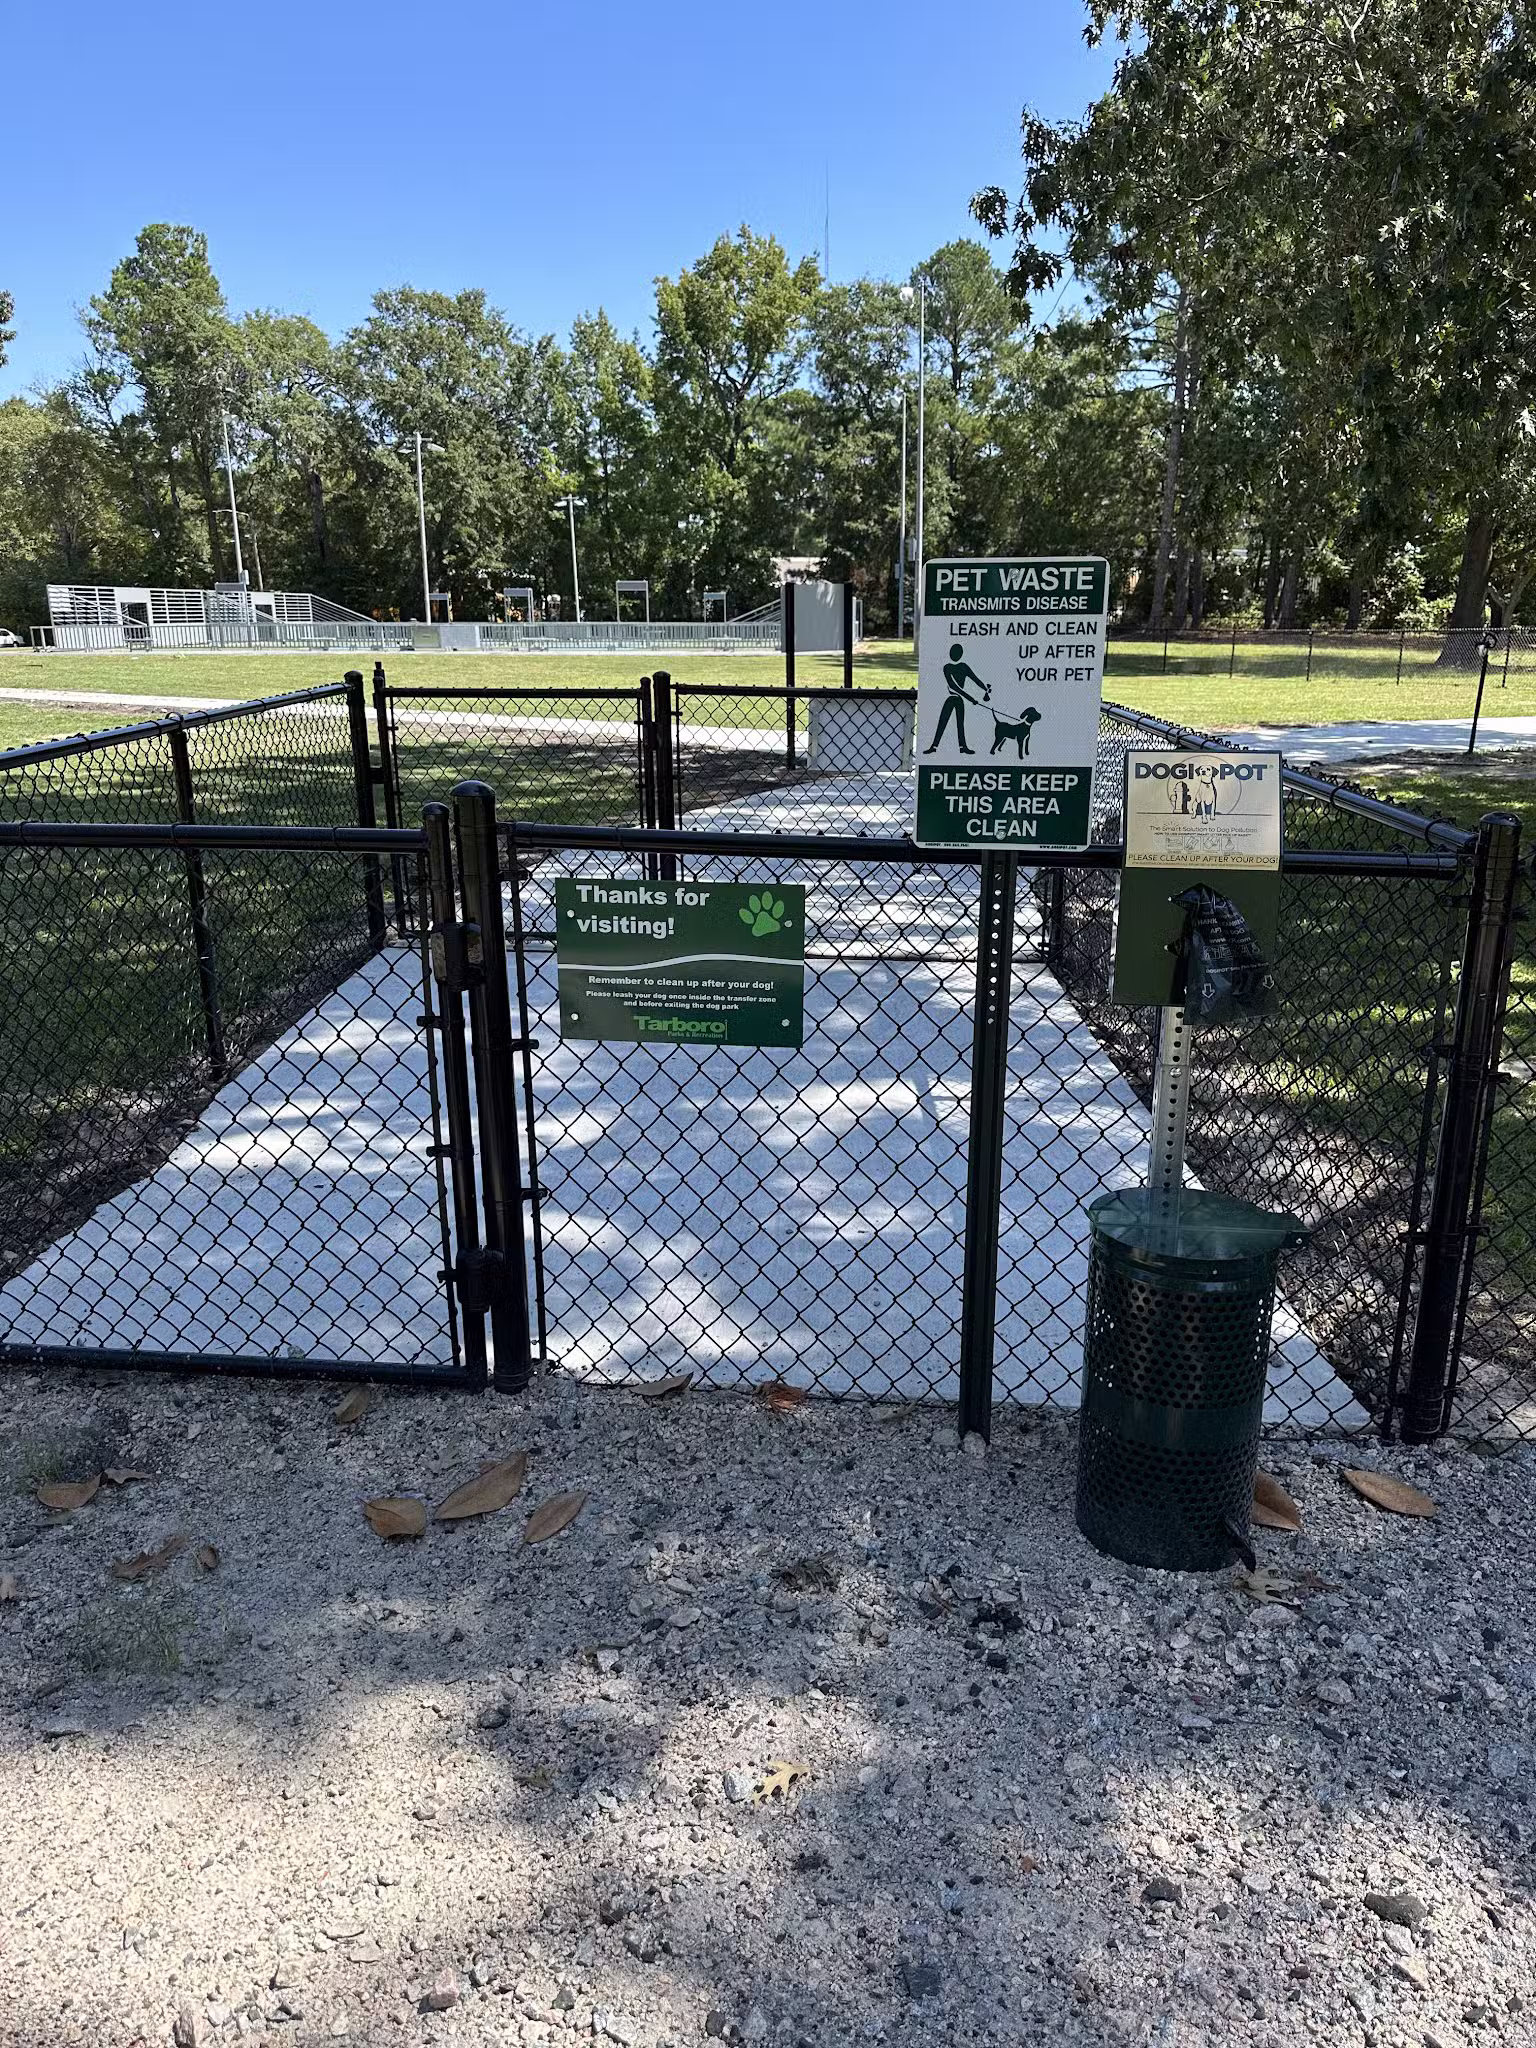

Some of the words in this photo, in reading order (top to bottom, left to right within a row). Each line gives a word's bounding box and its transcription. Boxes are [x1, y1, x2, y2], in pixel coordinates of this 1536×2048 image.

[936, 568, 988, 592] PET
[999, 566, 1095, 591] WASTE
[940, 597, 1021, 611] TRANSMITS
[1026, 596, 1088, 610] DISEASE
[950, 622, 999, 636] LEASH
[1006, 622, 1038, 636] AND
[1045, 621, 1098, 635] CLEAN
[1018, 645, 1039, 659] UP
[1045, 644, 1096, 658] AFTER
[1016, 668, 1057, 681] YOUR
[1064, 667, 1095, 681] PET
[930, 772, 1012, 791] PLEASE
[1021, 773, 1079, 792] KEEP
[945, 795, 993, 814] THIS
[1002, 796, 1060, 815] AREA
[966, 818, 1037, 838] CLEAN
[1128, 854, 1157, 862] PLEASE
[1202, 855, 1229, 863] AFTER
[1230, 856, 1254, 864] YOUR
[576, 884, 668, 905] Thanks
[675, 887, 710, 907] for
[576, 915, 675, 940] visiting!
[588, 975, 641, 985] Remember
[643, 977, 654, 985] to
[656, 977, 684, 986] clean
[686, 980, 699, 988] up
[701, 979, 726, 988] after
[727, 981, 750, 990] your
[752, 980, 774, 991] dog!
[585, 990, 611, 998] Please
[652, 992, 667, 1000] dog
[688, 993, 711, 1001] inside
[638, 1000, 663, 1008] before
[664, 1001, 690, 1009] exiting
[705, 1002, 720, 1011] dog
[721, 1003, 740, 1011] park
[633, 1015, 726, 1034] Tarboro
[691, 1031, 724, 1039] Recreation
